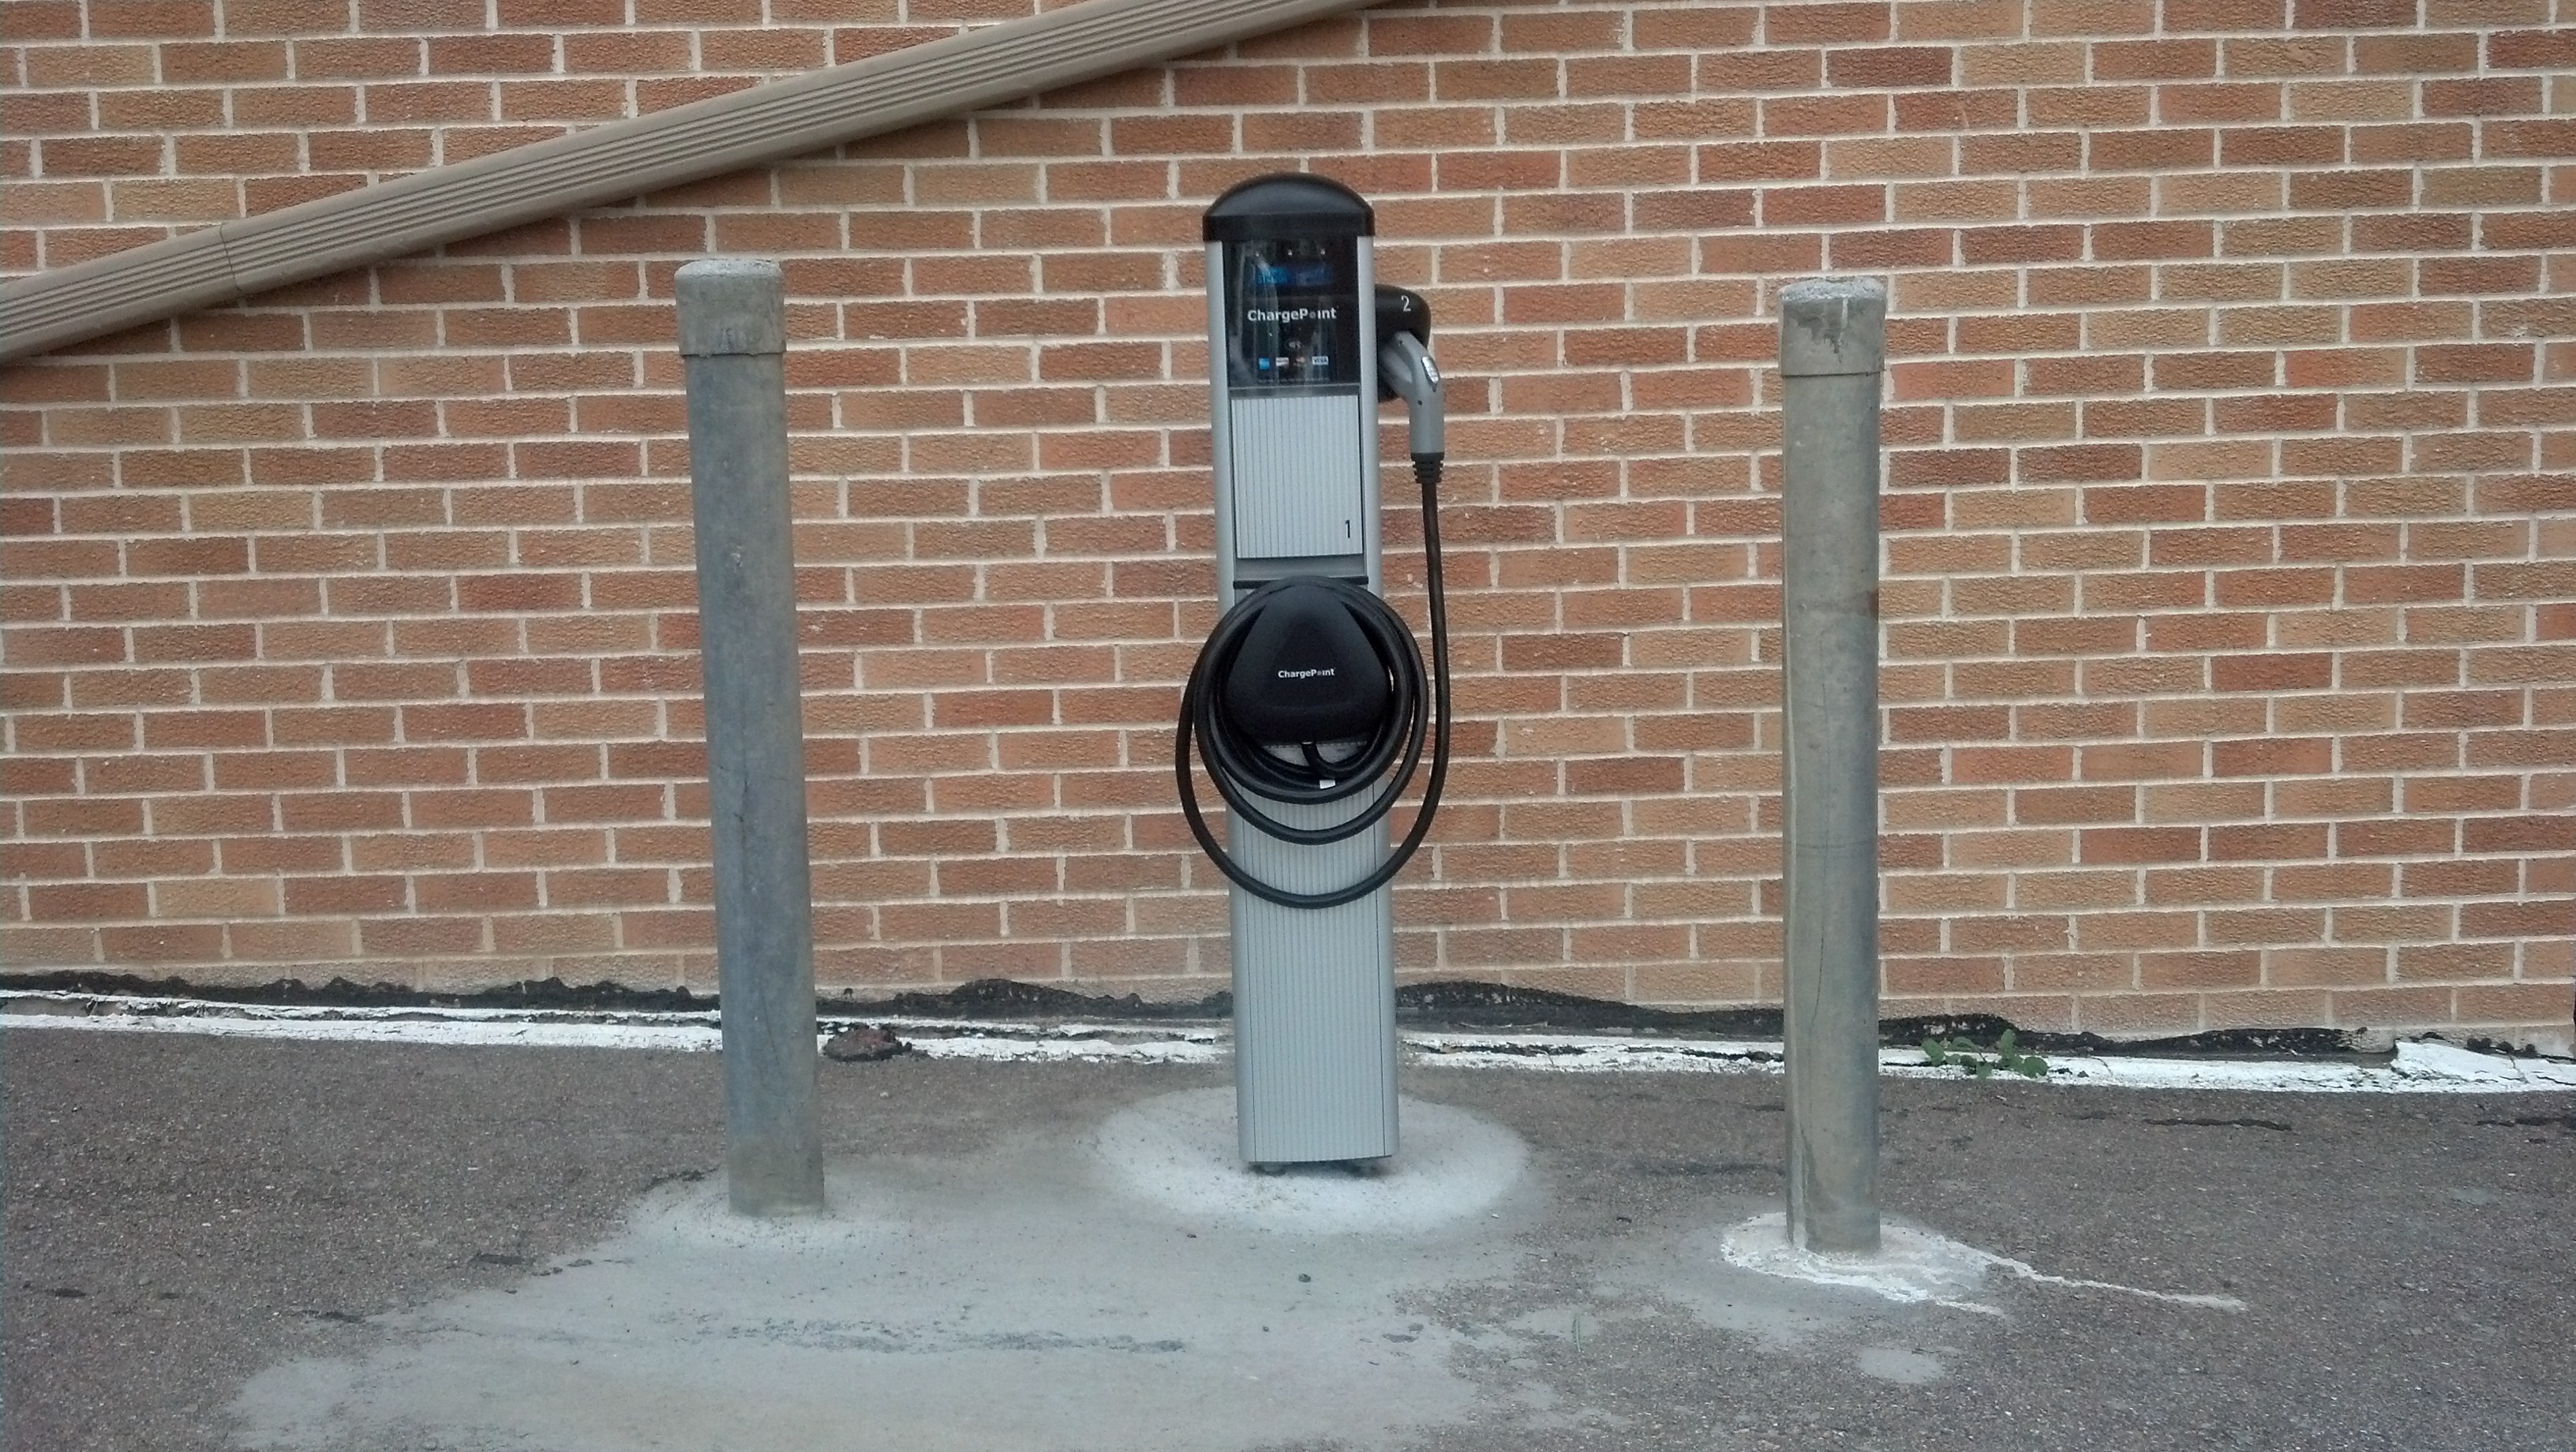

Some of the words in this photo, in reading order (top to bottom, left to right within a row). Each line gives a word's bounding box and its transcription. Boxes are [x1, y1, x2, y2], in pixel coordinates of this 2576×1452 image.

[1401, 295, 1411, 312] 2
[1248, 307, 1337, 323] ChargePoint
[1346, 520, 1350, 538] 1
[1278, 668, 1335, 679] ChargePoint
